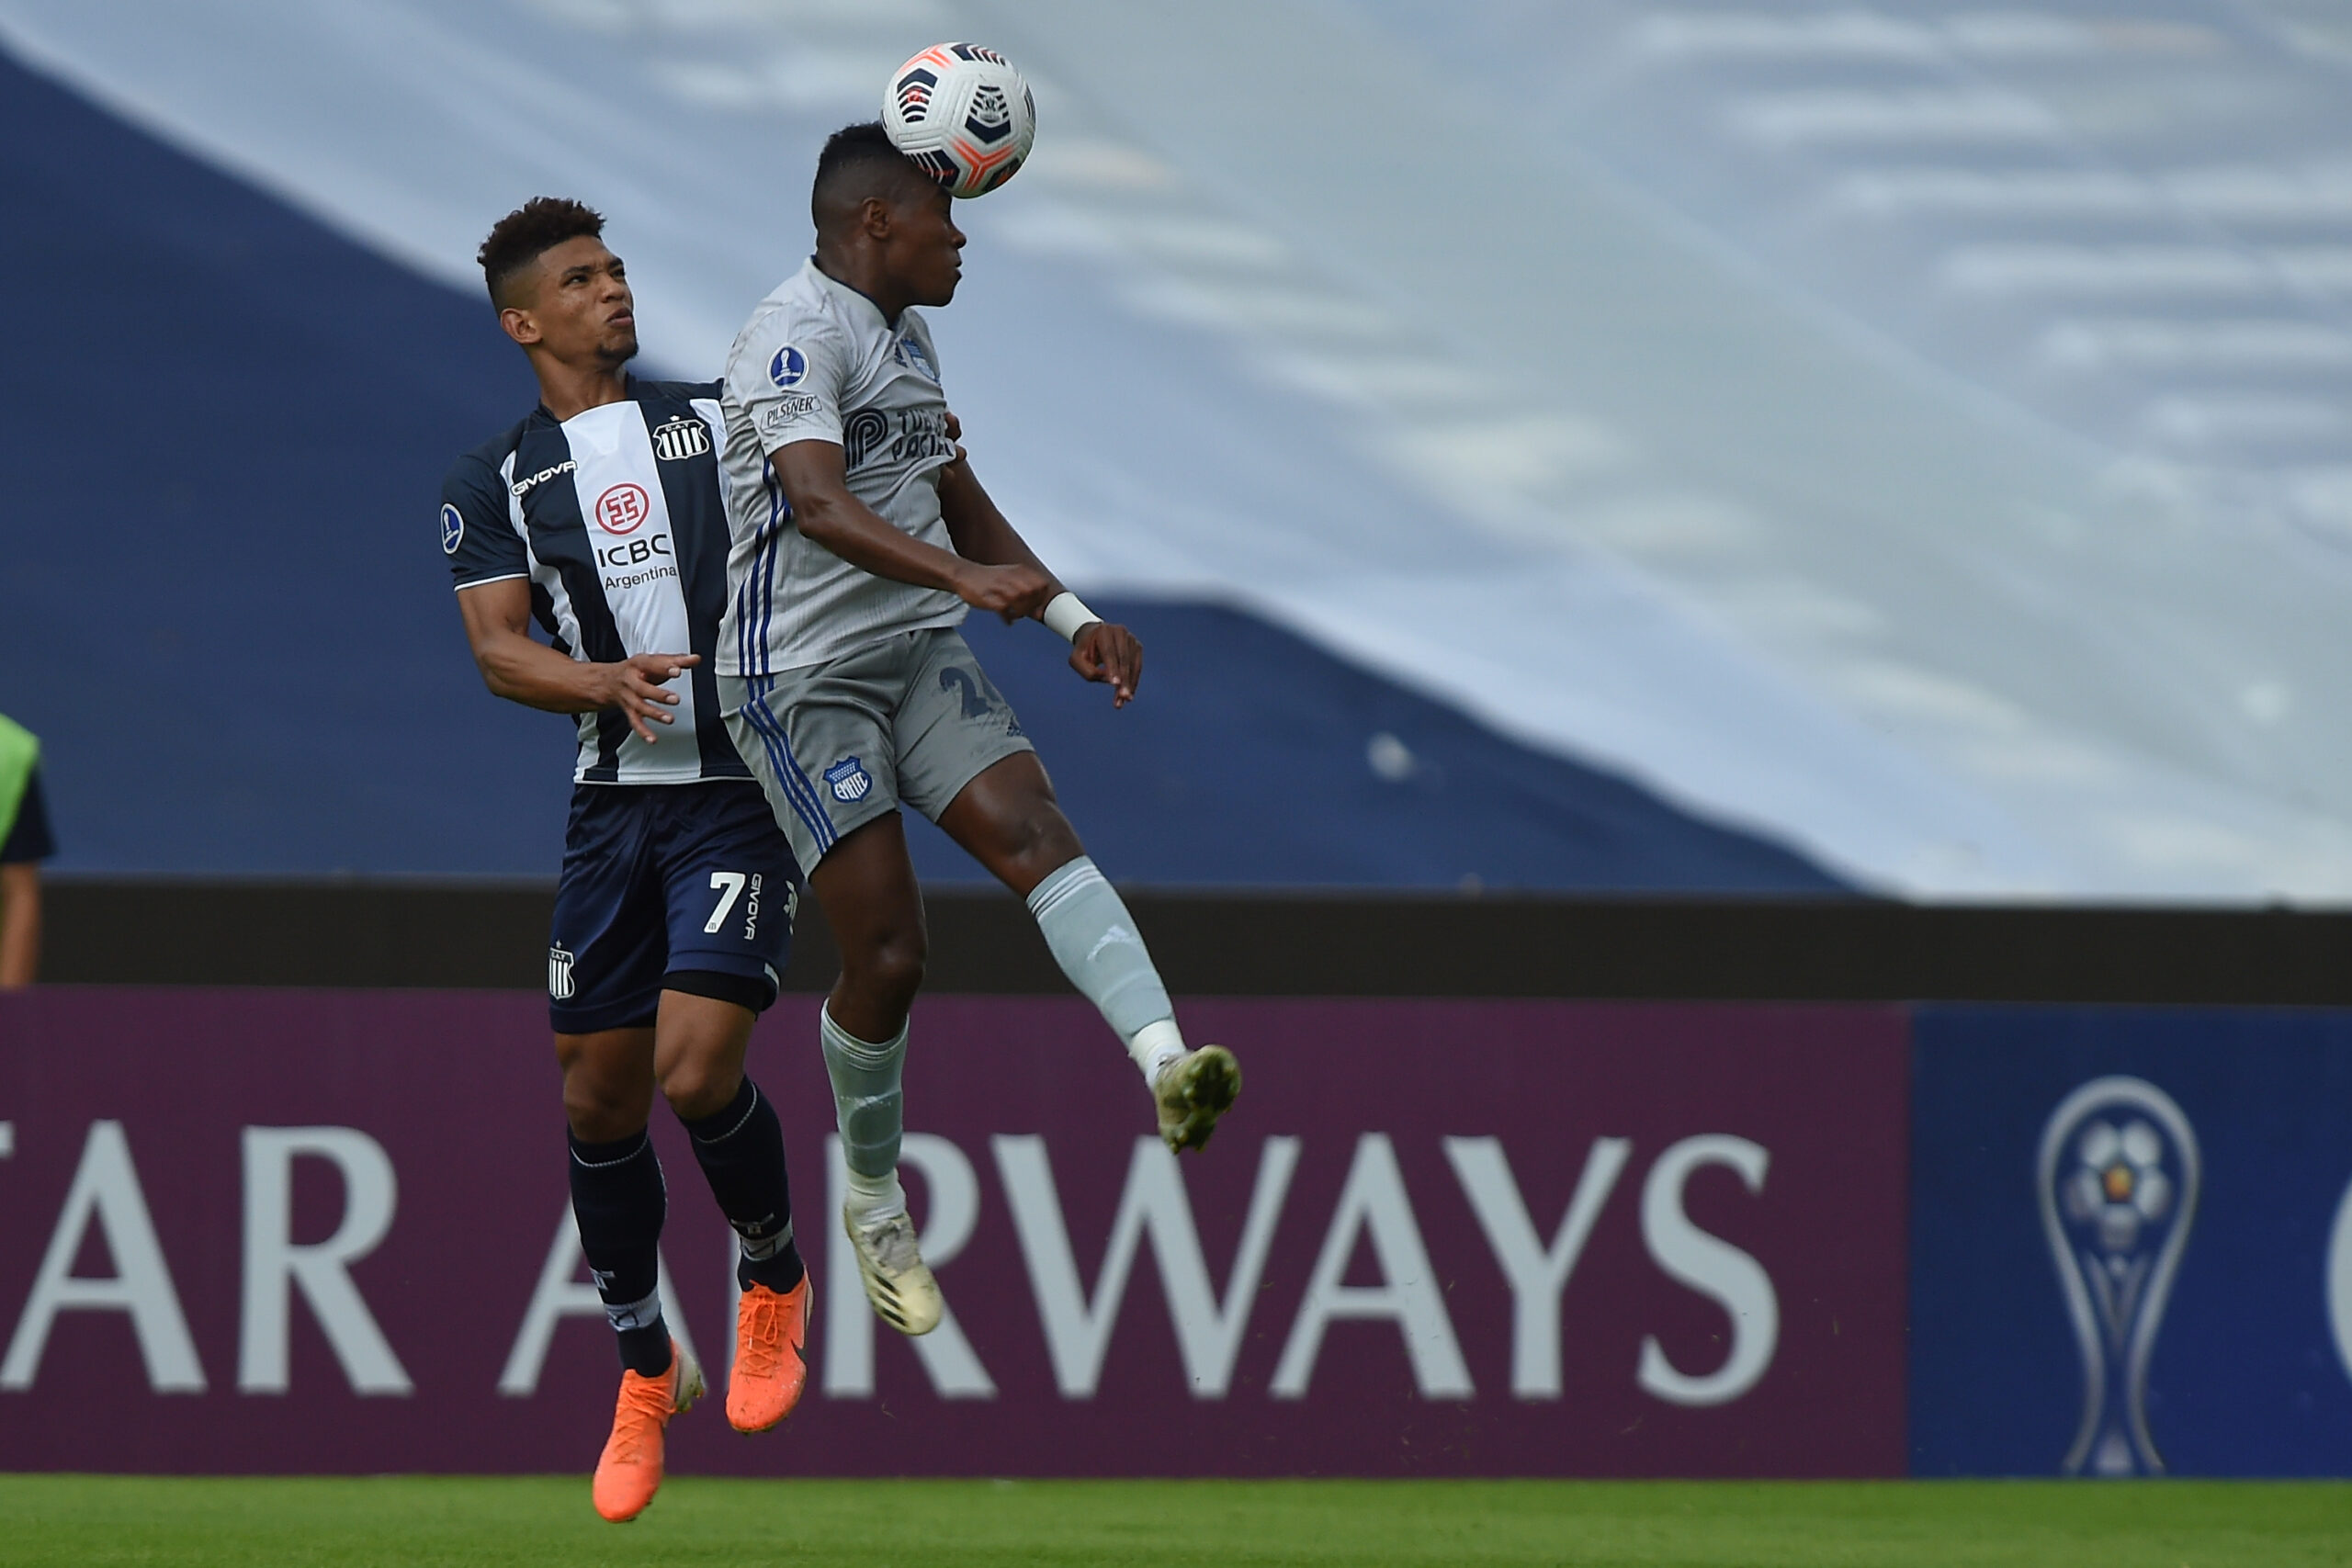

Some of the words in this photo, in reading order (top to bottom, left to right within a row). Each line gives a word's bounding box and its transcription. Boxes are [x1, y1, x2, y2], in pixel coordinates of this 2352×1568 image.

[767, 396, 814, 426] PILSENER
[511, 460, 579, 496] GIVOVA
[597, 534, 672, 568] ICBC
[605, 566, 678, 591] Argentina
[834, 771, 868, 800] EMELEC
[704, 872, 746, 933] 7
[743, 873, 763, 941] GIVOVA
[0, 1120, 414, 1395] AR
